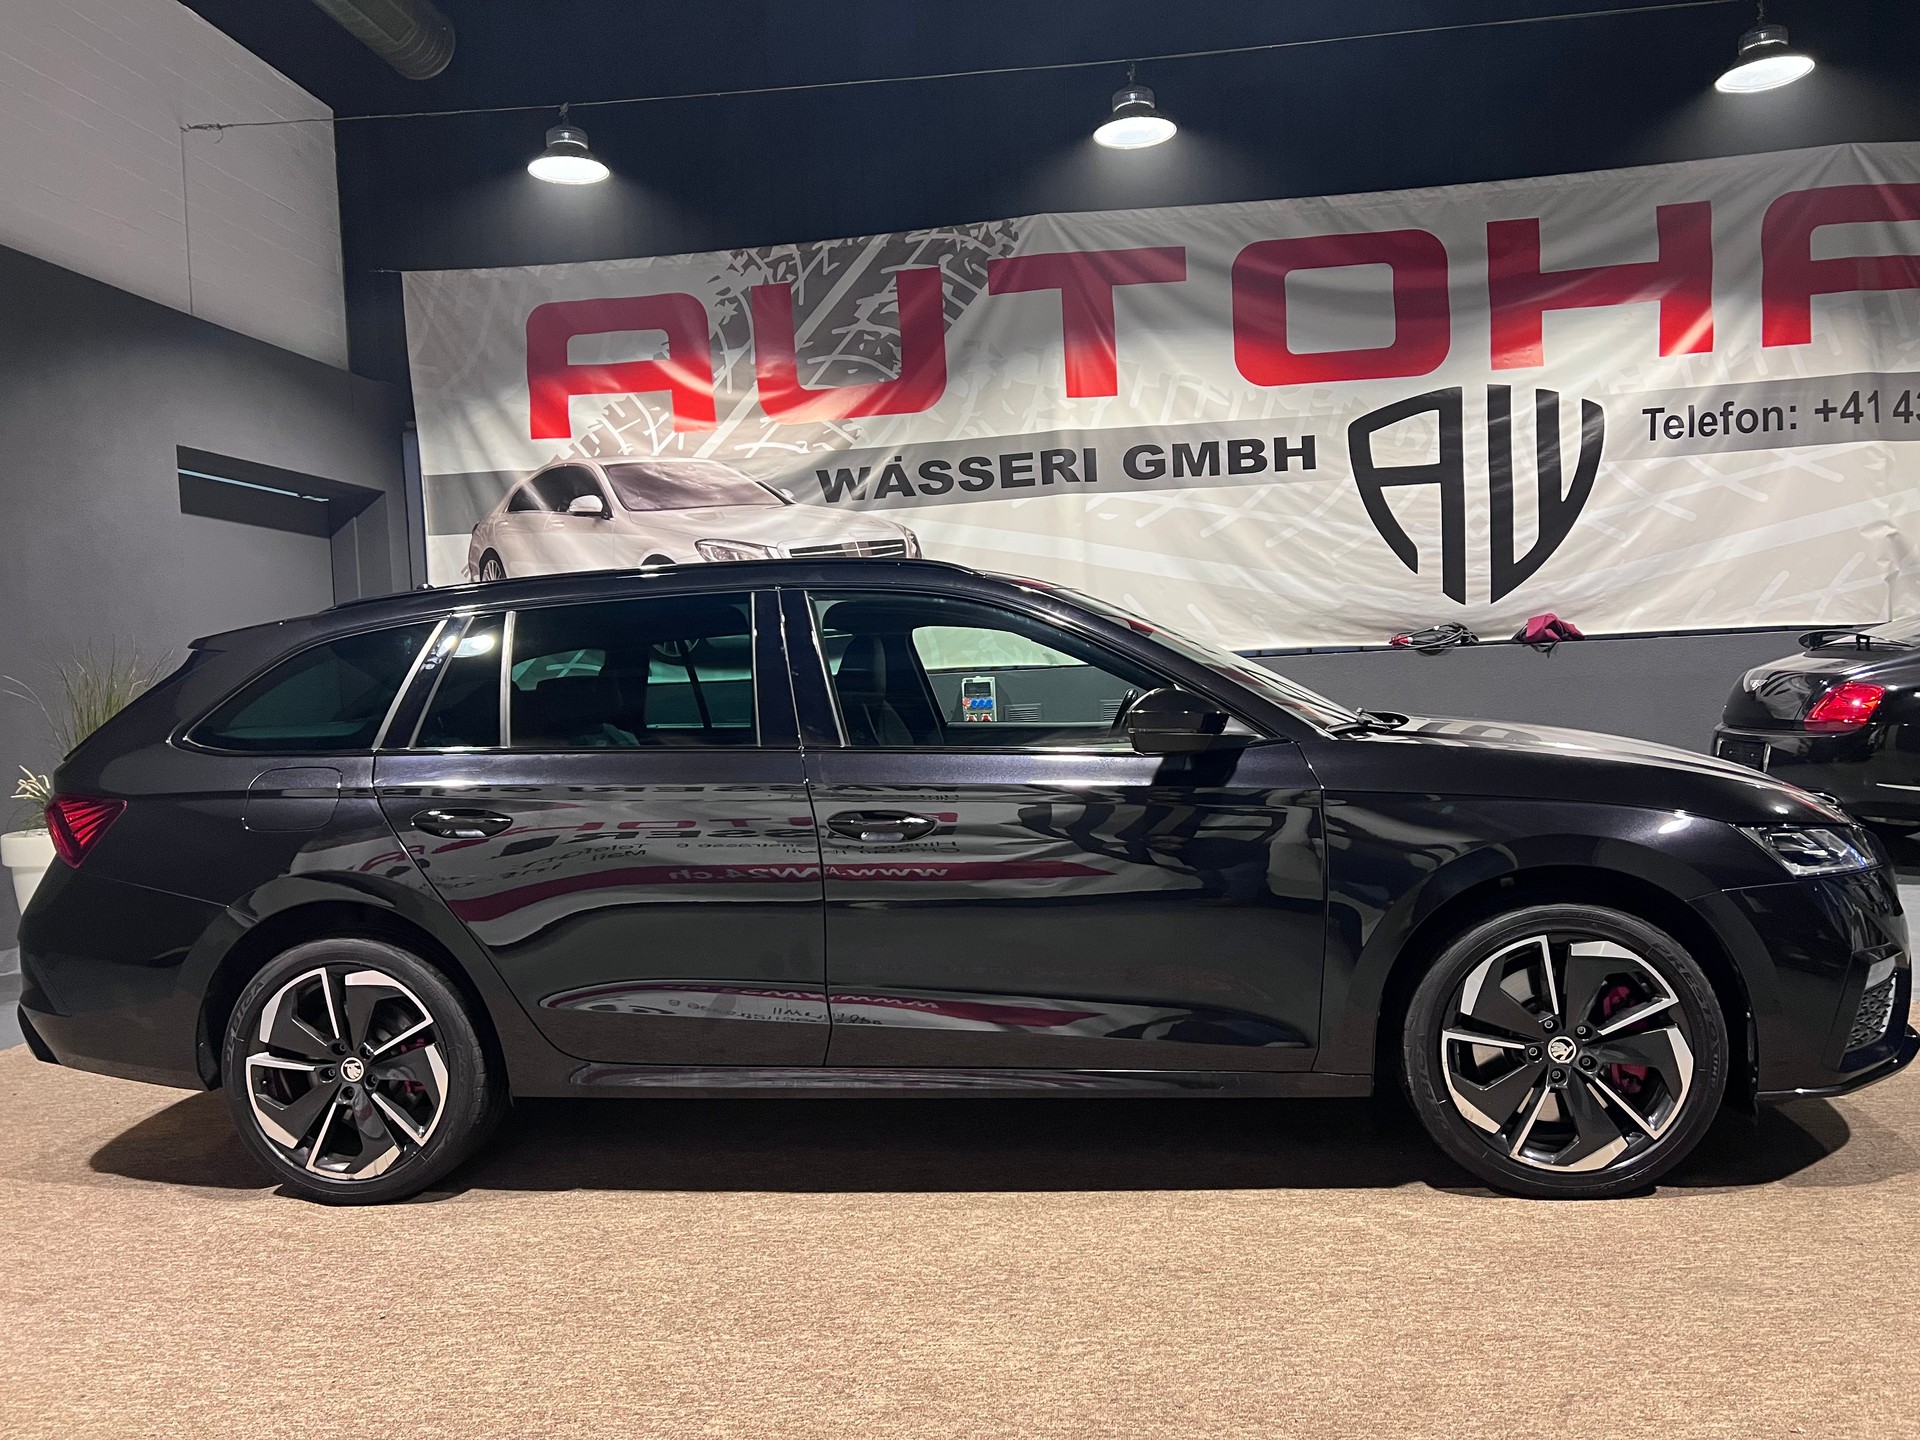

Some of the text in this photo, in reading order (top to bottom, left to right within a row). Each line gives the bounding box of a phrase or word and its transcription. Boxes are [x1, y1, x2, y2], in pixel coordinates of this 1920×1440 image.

[1642, 389, 1920, 441] Telefon: +41 4
[1122, 435, 1316, 480] GMBH
